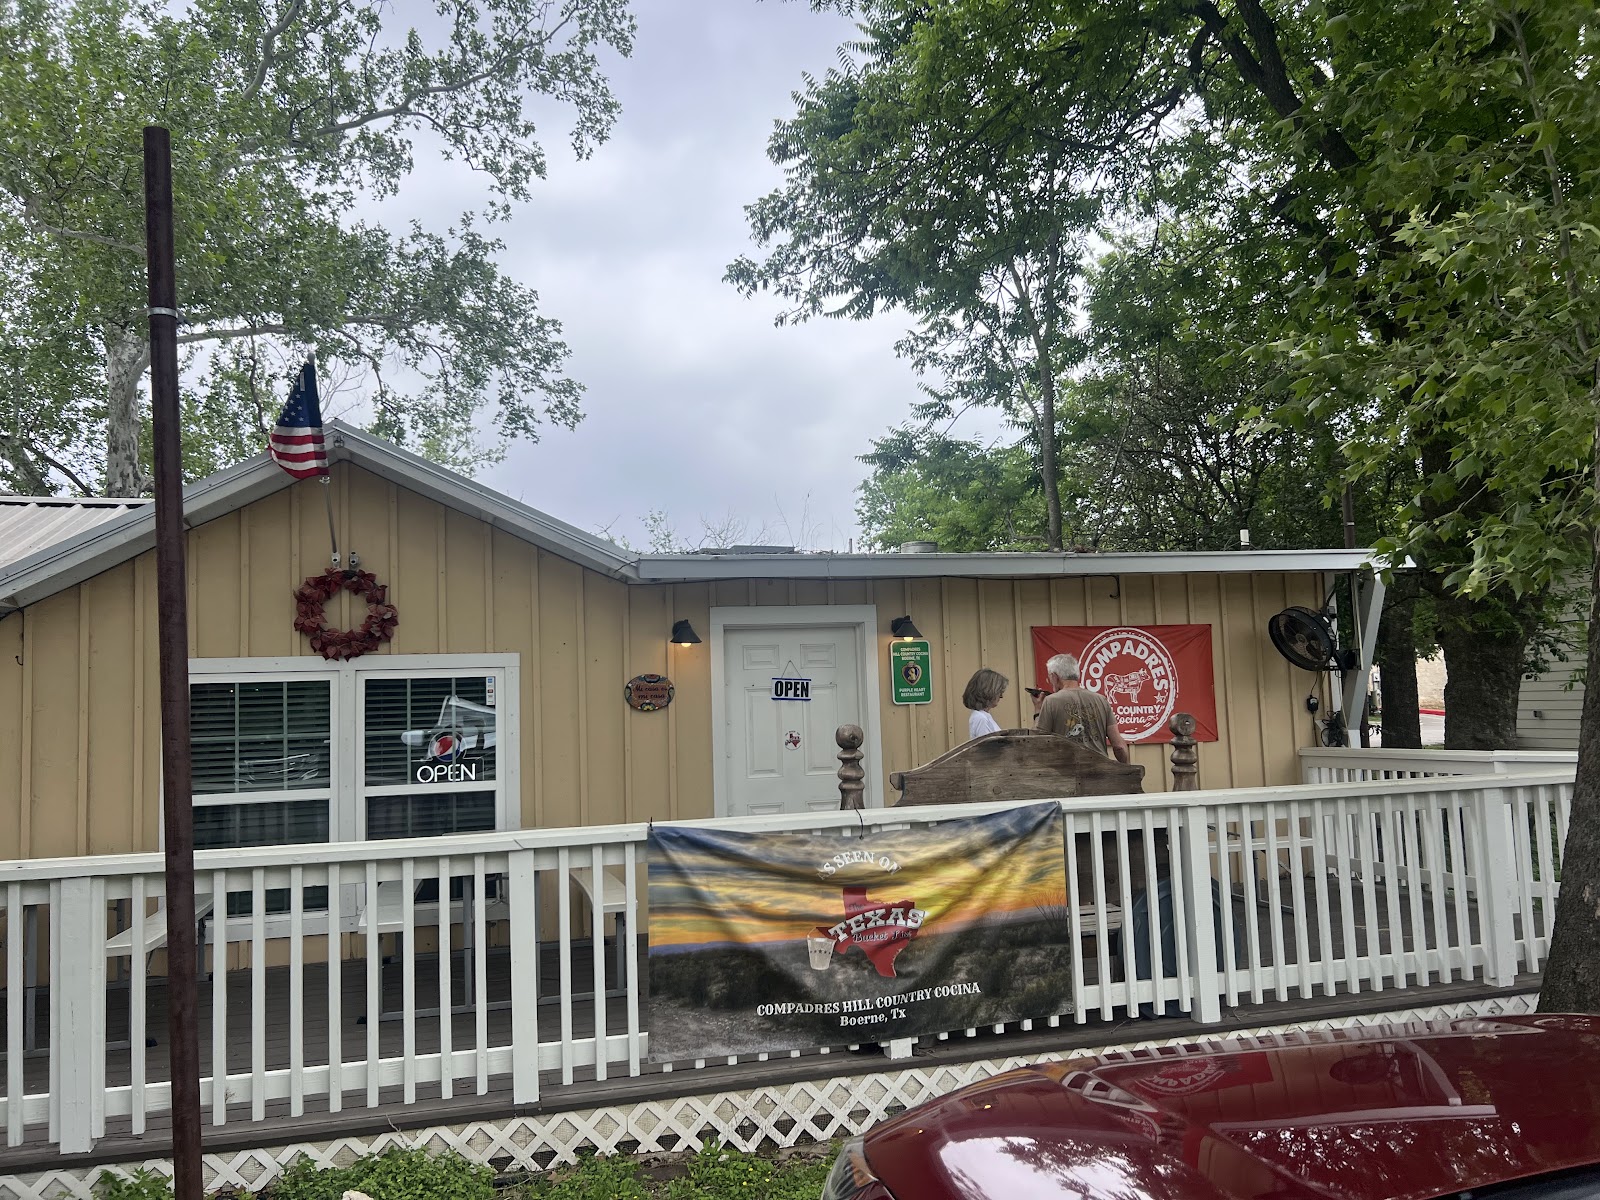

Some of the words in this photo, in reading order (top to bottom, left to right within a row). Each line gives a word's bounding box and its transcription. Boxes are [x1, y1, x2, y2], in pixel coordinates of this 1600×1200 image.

[1085, 640, 1168, 693] COMPADRES
[774, 680, 809, 698] OPEN
[1117, 704, 1160, 715] COUNTRY
[416, 763, 476, 783] OPEN
[833, 850, 876, 868] SEEN
[879, 856, 902, 875] ON
[828, 907, 926, 942] TEXAS
[852, 931, 888, 943] Bucket
[756, 1002, 840, 1017] COMPADRES
[842, 998, 874, 1013] HILL
[875, 987, 933, 1009] COUNTRY
[934, 982, 982, 998] COCINA
[839, 1012, 888, 1027] Boerne,
[890, 1008, 907, 1020] Tx
